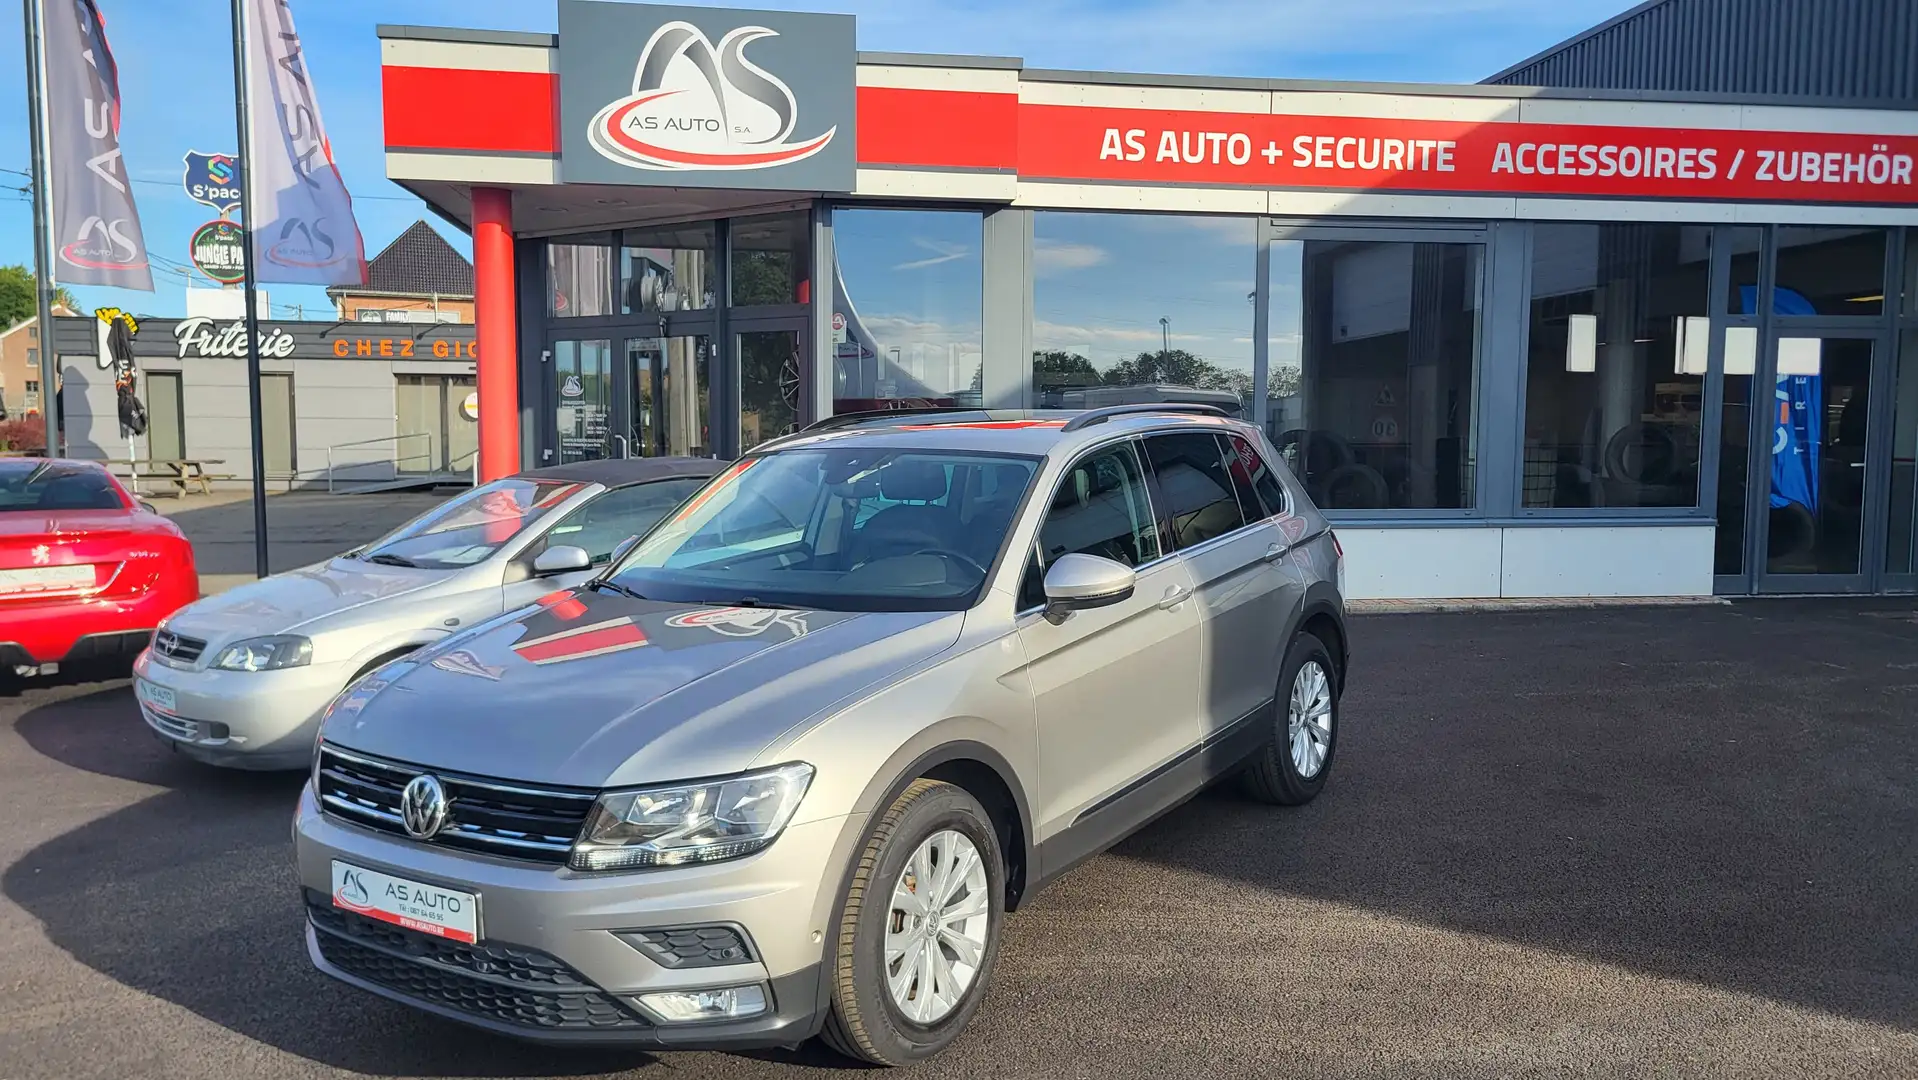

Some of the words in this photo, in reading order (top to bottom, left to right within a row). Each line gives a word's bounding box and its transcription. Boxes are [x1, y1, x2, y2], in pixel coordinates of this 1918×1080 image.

[628, 116, 658, 130] AS
[664, 117, 720, 132] AUTO
[1099, 127, 1146, 163] AS
[1155, 130, 1252, 167] AUTO
[1260, 147, 1284, 165] +
[1292, 134, 1456, 172] SECURITE
[1491, 141, 1718, 180] ACCESSOIRES
[1726, 148, 1746, 180] /
[1755, 143, 1914, 186] ZUBEHÖR
[193, 184, 241, 200] S'pac
[193, 243, 229, 265] JUNGLE
[334, 339, 415, 357] CHEZ
[385, 882, 409, 902] AS
[413, 889, 461, 913] AUTO
